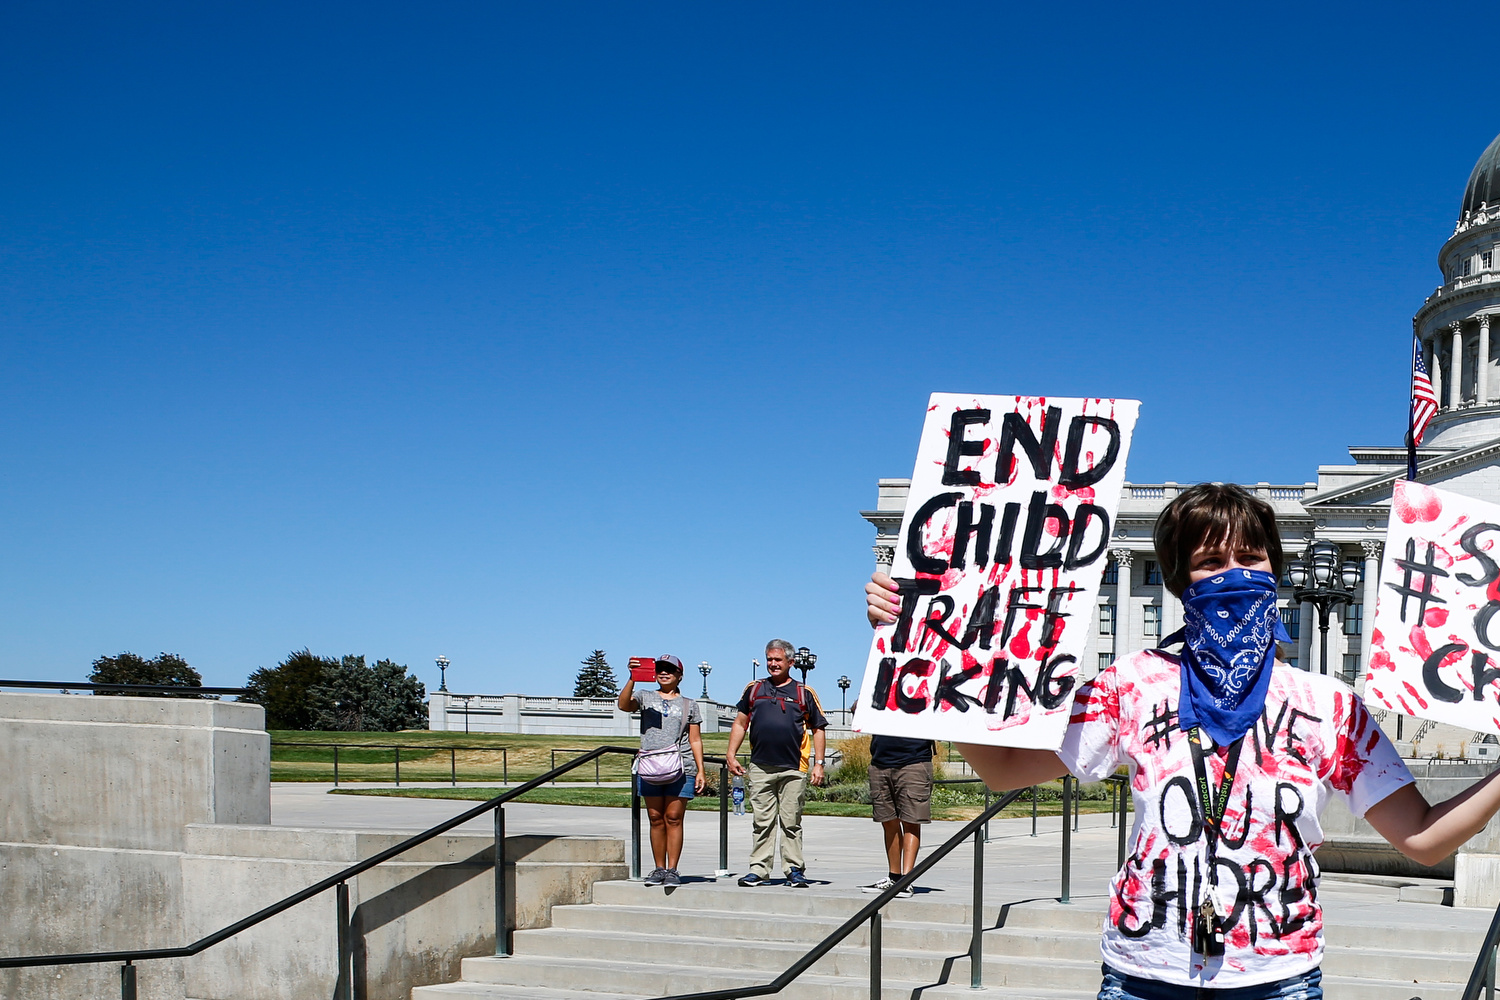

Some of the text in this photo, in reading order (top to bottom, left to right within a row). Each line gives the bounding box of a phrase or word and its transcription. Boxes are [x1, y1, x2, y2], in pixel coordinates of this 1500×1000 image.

[941, 406, 1121, 490] END
[892, 576, 1086, 654] TRAFF
[872, 653, 1076, 721] ICKING
[1160, 775, 1308, 850] OUR
